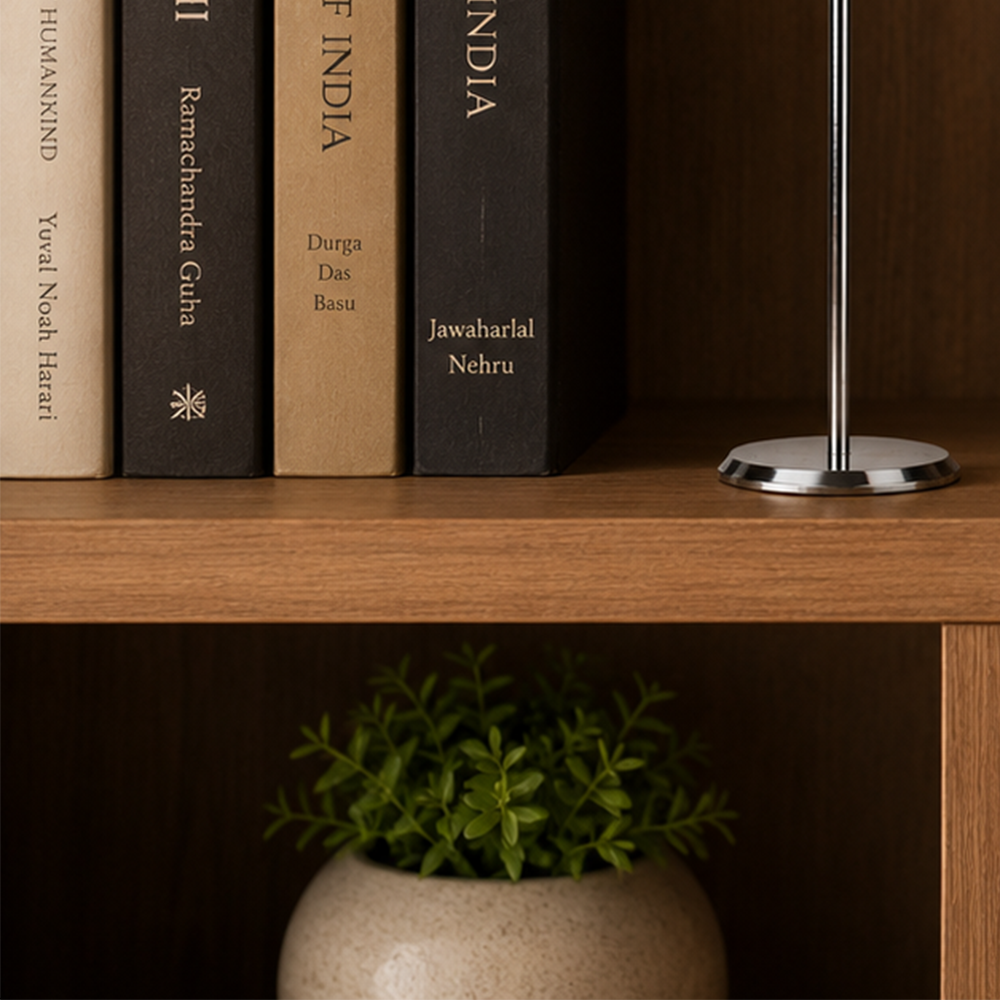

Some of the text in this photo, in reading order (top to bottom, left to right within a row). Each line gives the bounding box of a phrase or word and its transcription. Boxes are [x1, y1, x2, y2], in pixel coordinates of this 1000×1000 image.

[39, 8, 58, 162] HUMANKIND
[321, 34, 353, 153] INDIA
[179, 86, 203, 328] Ramachandra Guha
[306, 233, 363, 257] Durga
[317, 263, 352, 282] Das
[313, 293, 356, 312] Basu
[37, 211, 59, 421] Yuval Noah Harari
[427, 317, 535, 343] Jawaharlal
[447, 352, 515, 376] Nehru
